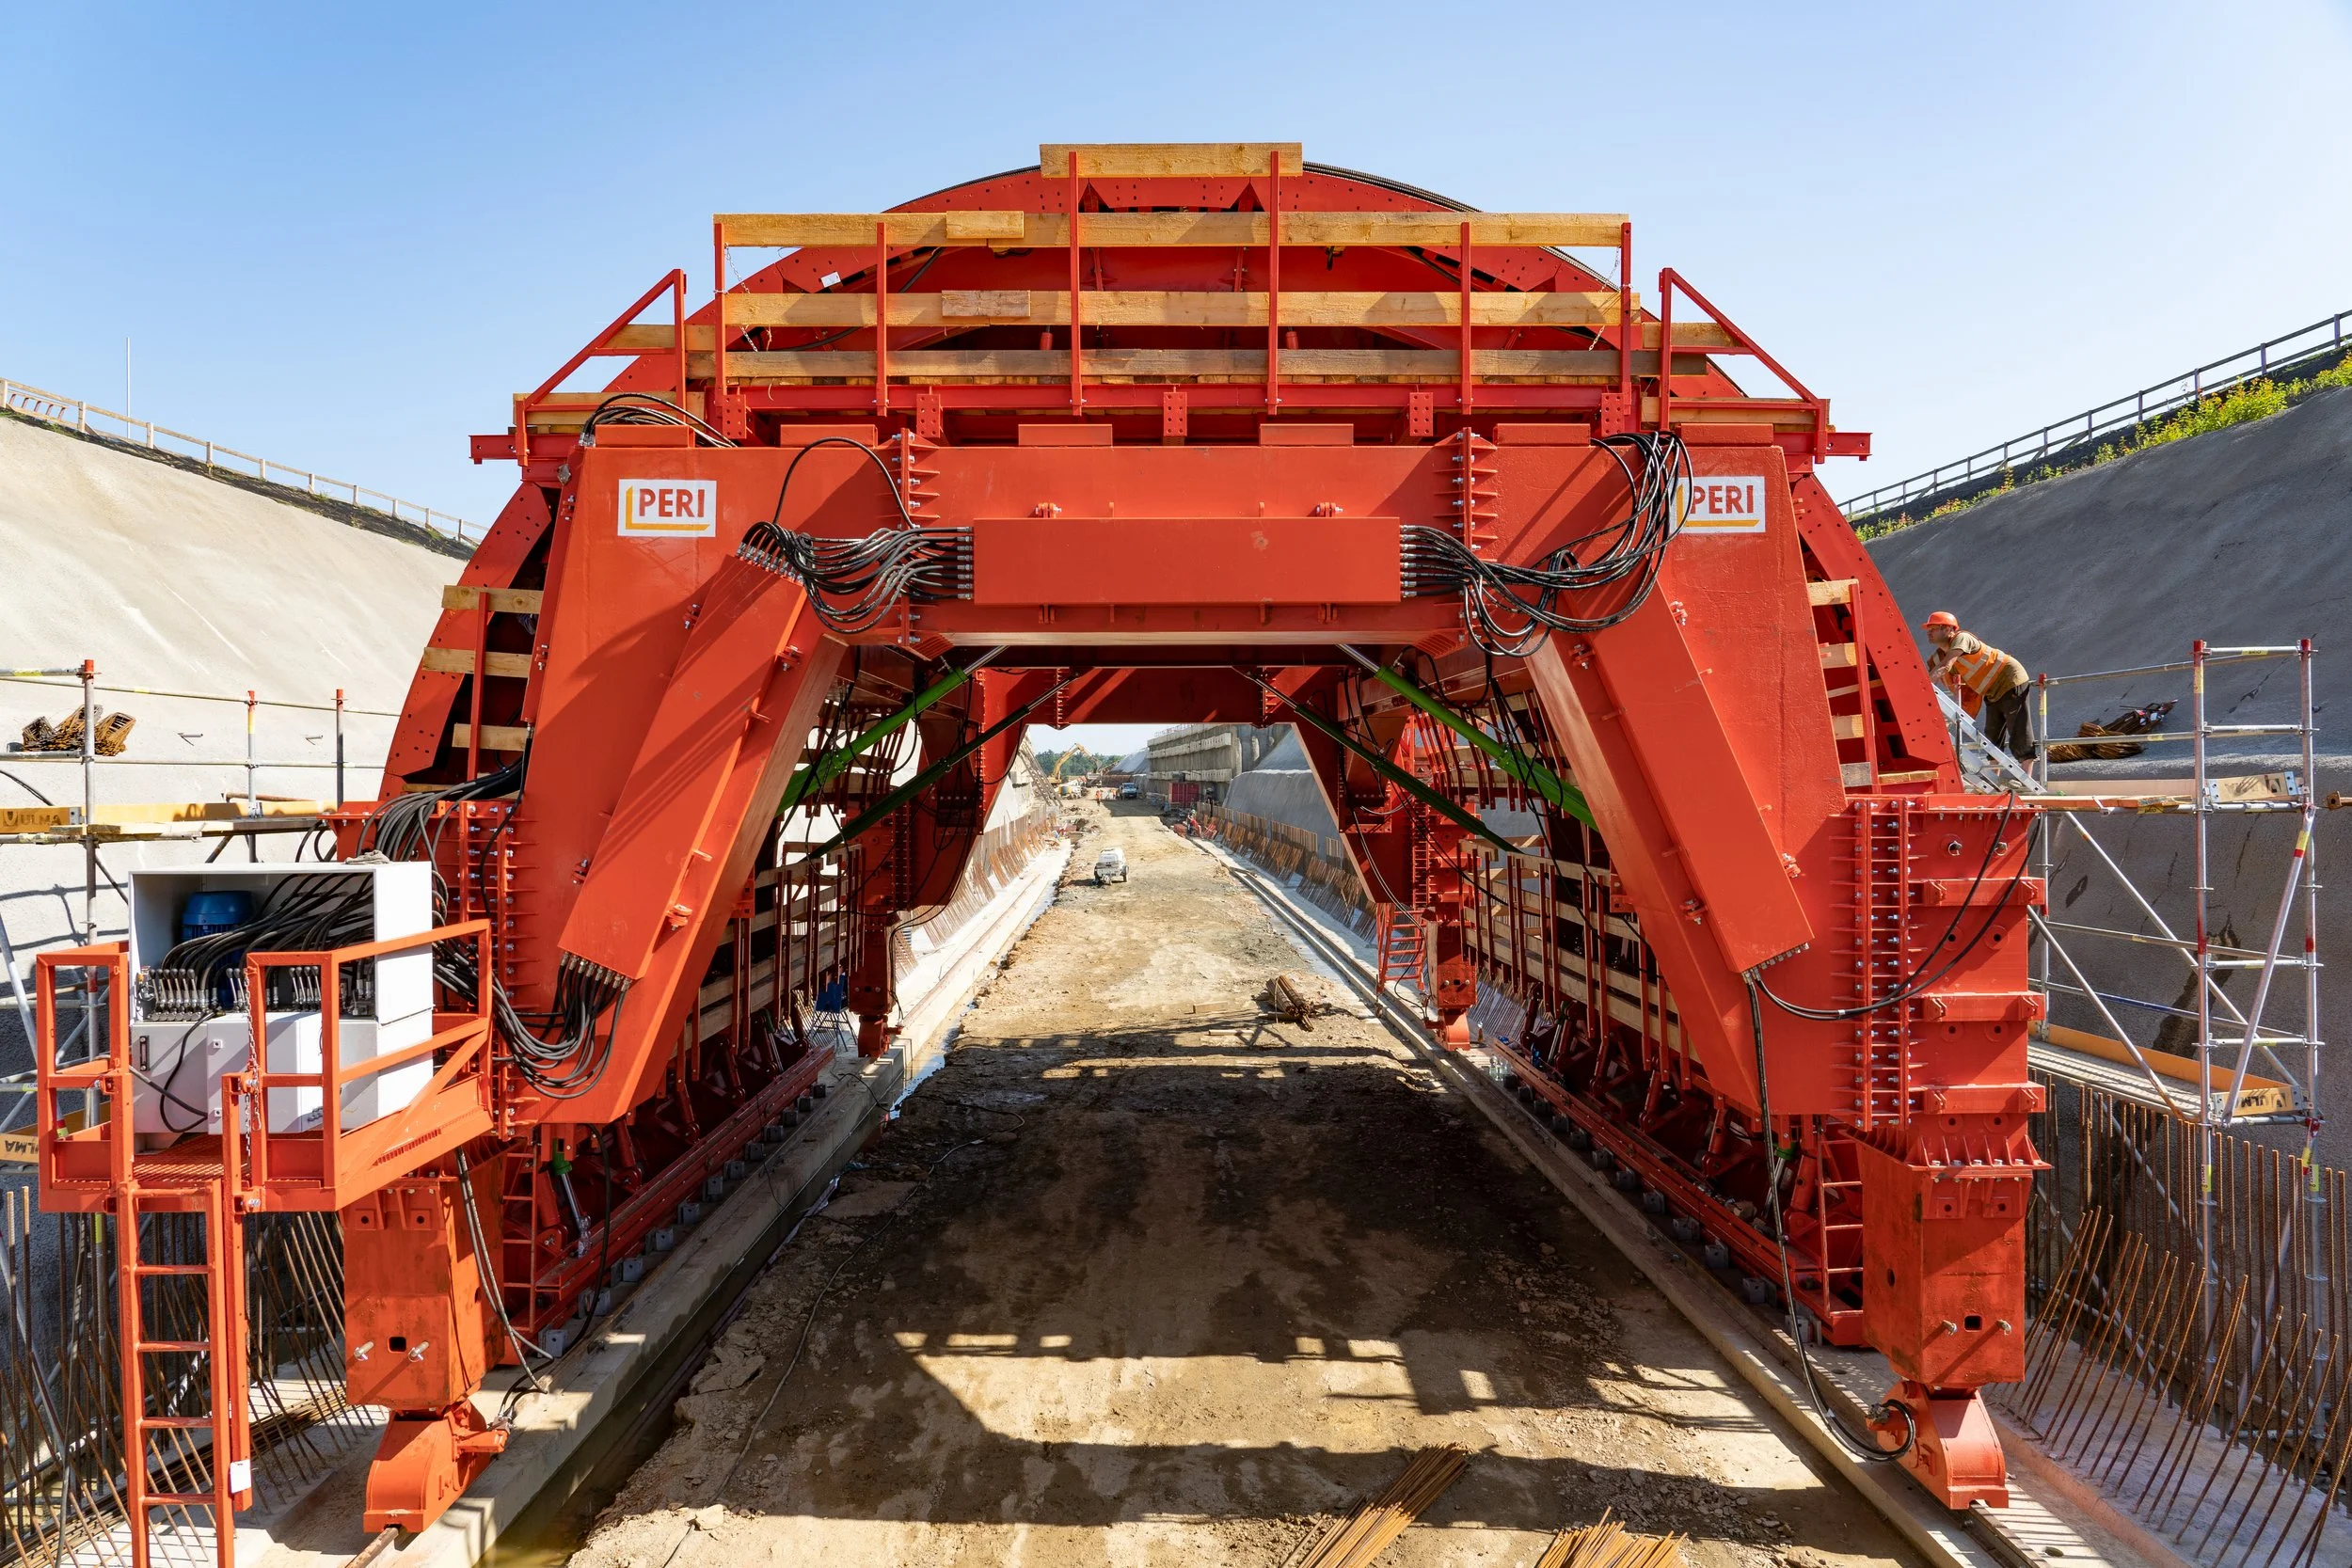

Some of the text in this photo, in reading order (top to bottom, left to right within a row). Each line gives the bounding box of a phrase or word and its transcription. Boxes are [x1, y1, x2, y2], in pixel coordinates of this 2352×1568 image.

[639, 488, 706, 517] PERI
[1690, 484, 1754, 515] PERI
[20, 814, 62, 826] ULMA
[2234, 1094, 2268, 1108] ULM
